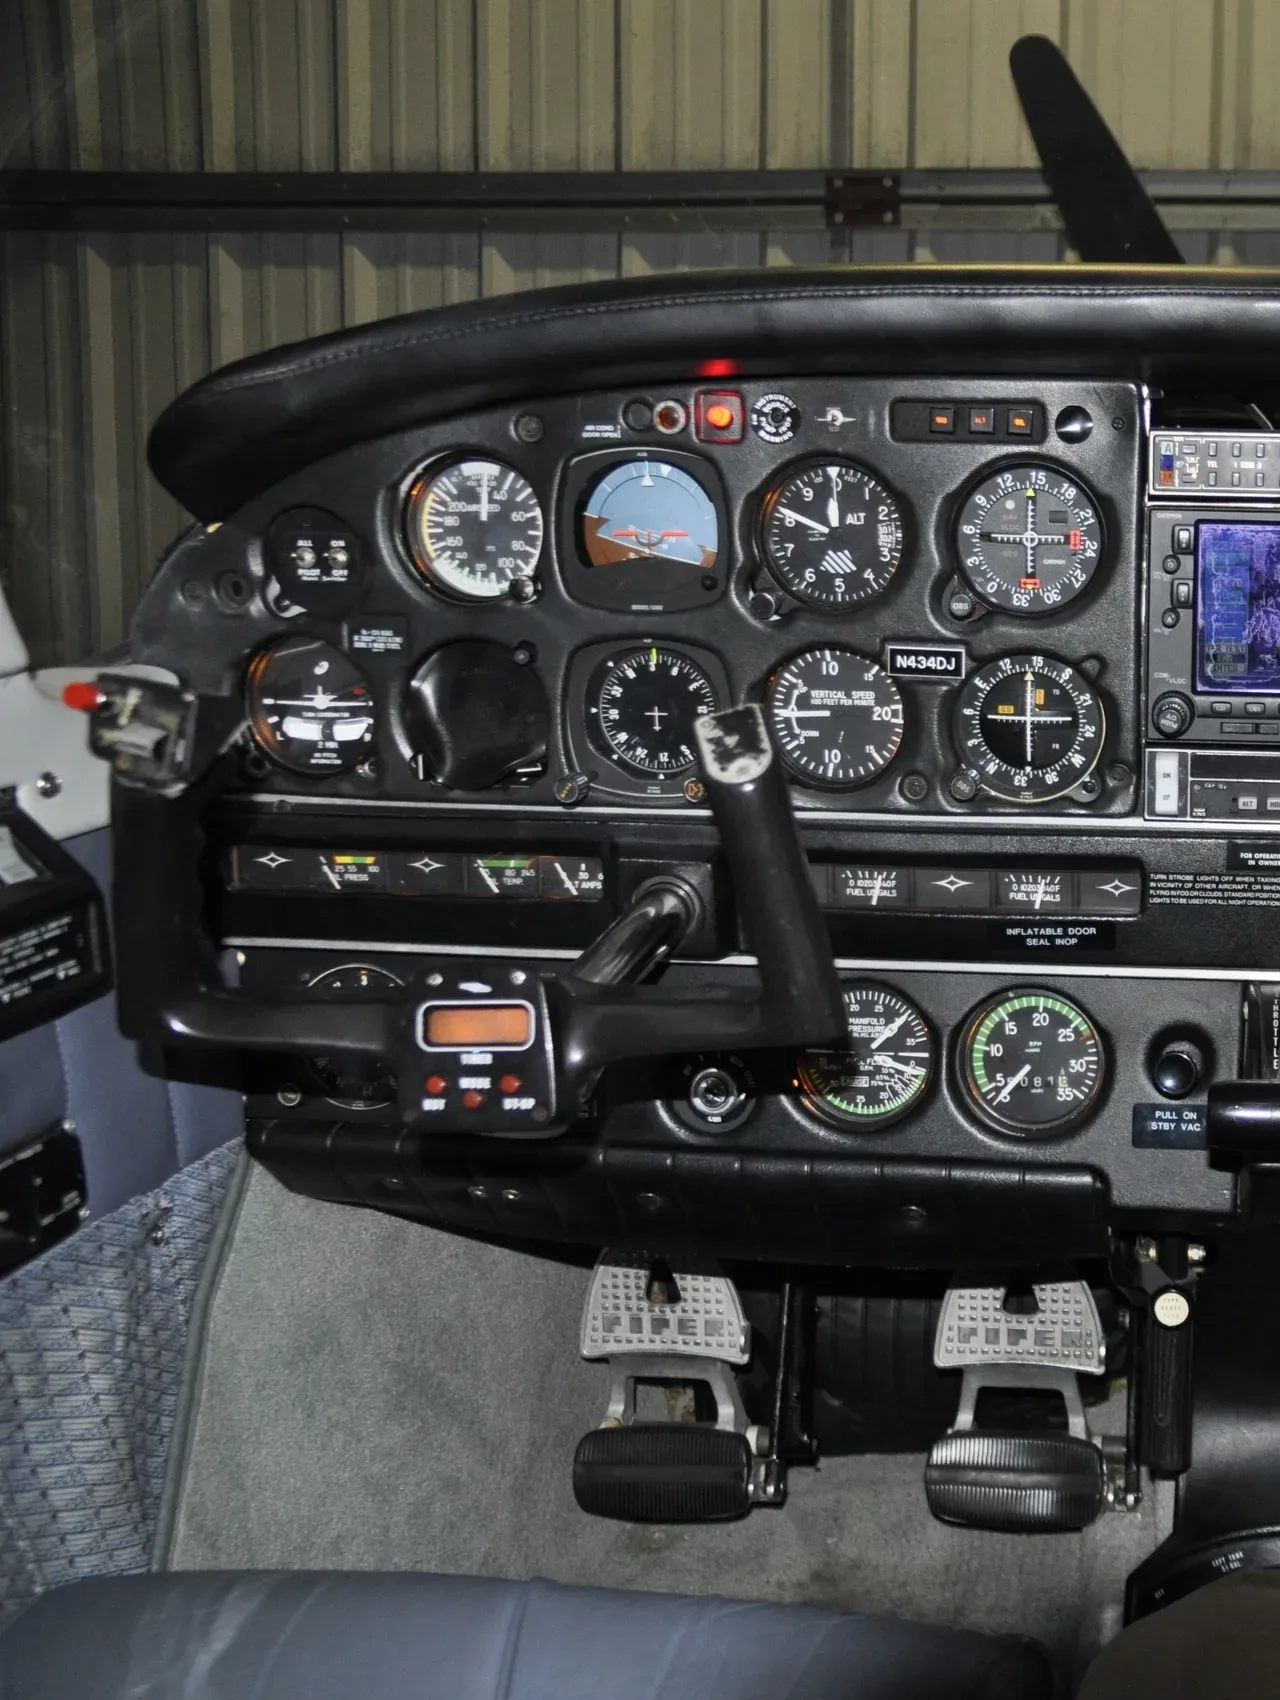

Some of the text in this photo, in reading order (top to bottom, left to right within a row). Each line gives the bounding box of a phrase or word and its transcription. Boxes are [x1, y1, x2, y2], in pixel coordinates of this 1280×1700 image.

[754, 394, 797, 409] INSTRUMENT
[762, 401, 790, 413] SOURCE
[779, 416, 792, 433] INOP
[758, 429, 793, 443] WARNING
[996, 473, 1015, 489] 12
[1030, 471, 1047, 485] 15
[493, 491, 507, 500] 40
[1060, 483, 1077, 500] 18
[448, 502, 467, 512] 200
[443, 516, 460, 526] 180
[511, 512, 526, 521] 60
[846, 513, 866, 525] ALT
[1079, 509, 1096, 526] 21
[446, 536, 463, 546] 160
[511, 541, 526, 550] 80
[1084, 540, 1098, 558] 24
[498, 558, 515, 568] 100
[1070, 568, 1087, 589] 27
[1012, 593, 1031, 607] 33
[1043, 588, 1062, 605] 30
[952, 602, 969, 611] OBS
[821, 661, 839, 676] 10
[896, 655, 956, 671] N434DJ
[864, 673, 874, 681] 15
[810, 690, 876, 700] VERTICAL SPEED
[872, 707, 892, 721] 20
[824, 749, 842, 763] 10
[866, 745, 875, 754] 15
[846, 888, 897, 897] FUEL GALS
[1009, 893, 1061, 902] FUEL GALS
[1006, 927, 1096, 935] INFLATABLE DOOR
[1026, 938, 1078, 946] SEAL INOP
[1032, 1013, 1049, 1026] 20
[1005, 1022, 1017, 1035] 15
[1058, 1029, 1075, 1042] 25
[990, 1044, 1003, 1057] 10
[1069, 1059, 1086, 1073] 30
[1056, 1088, 1074, 1101] 35
[1155, 1110, 1197, 1120] PULL ON
[1151, 1121, 1201, 1131] STBY VAC
[602, 1314, 724, 1337] PIPER
[958, 1325, 1083, 1347] PIPER
